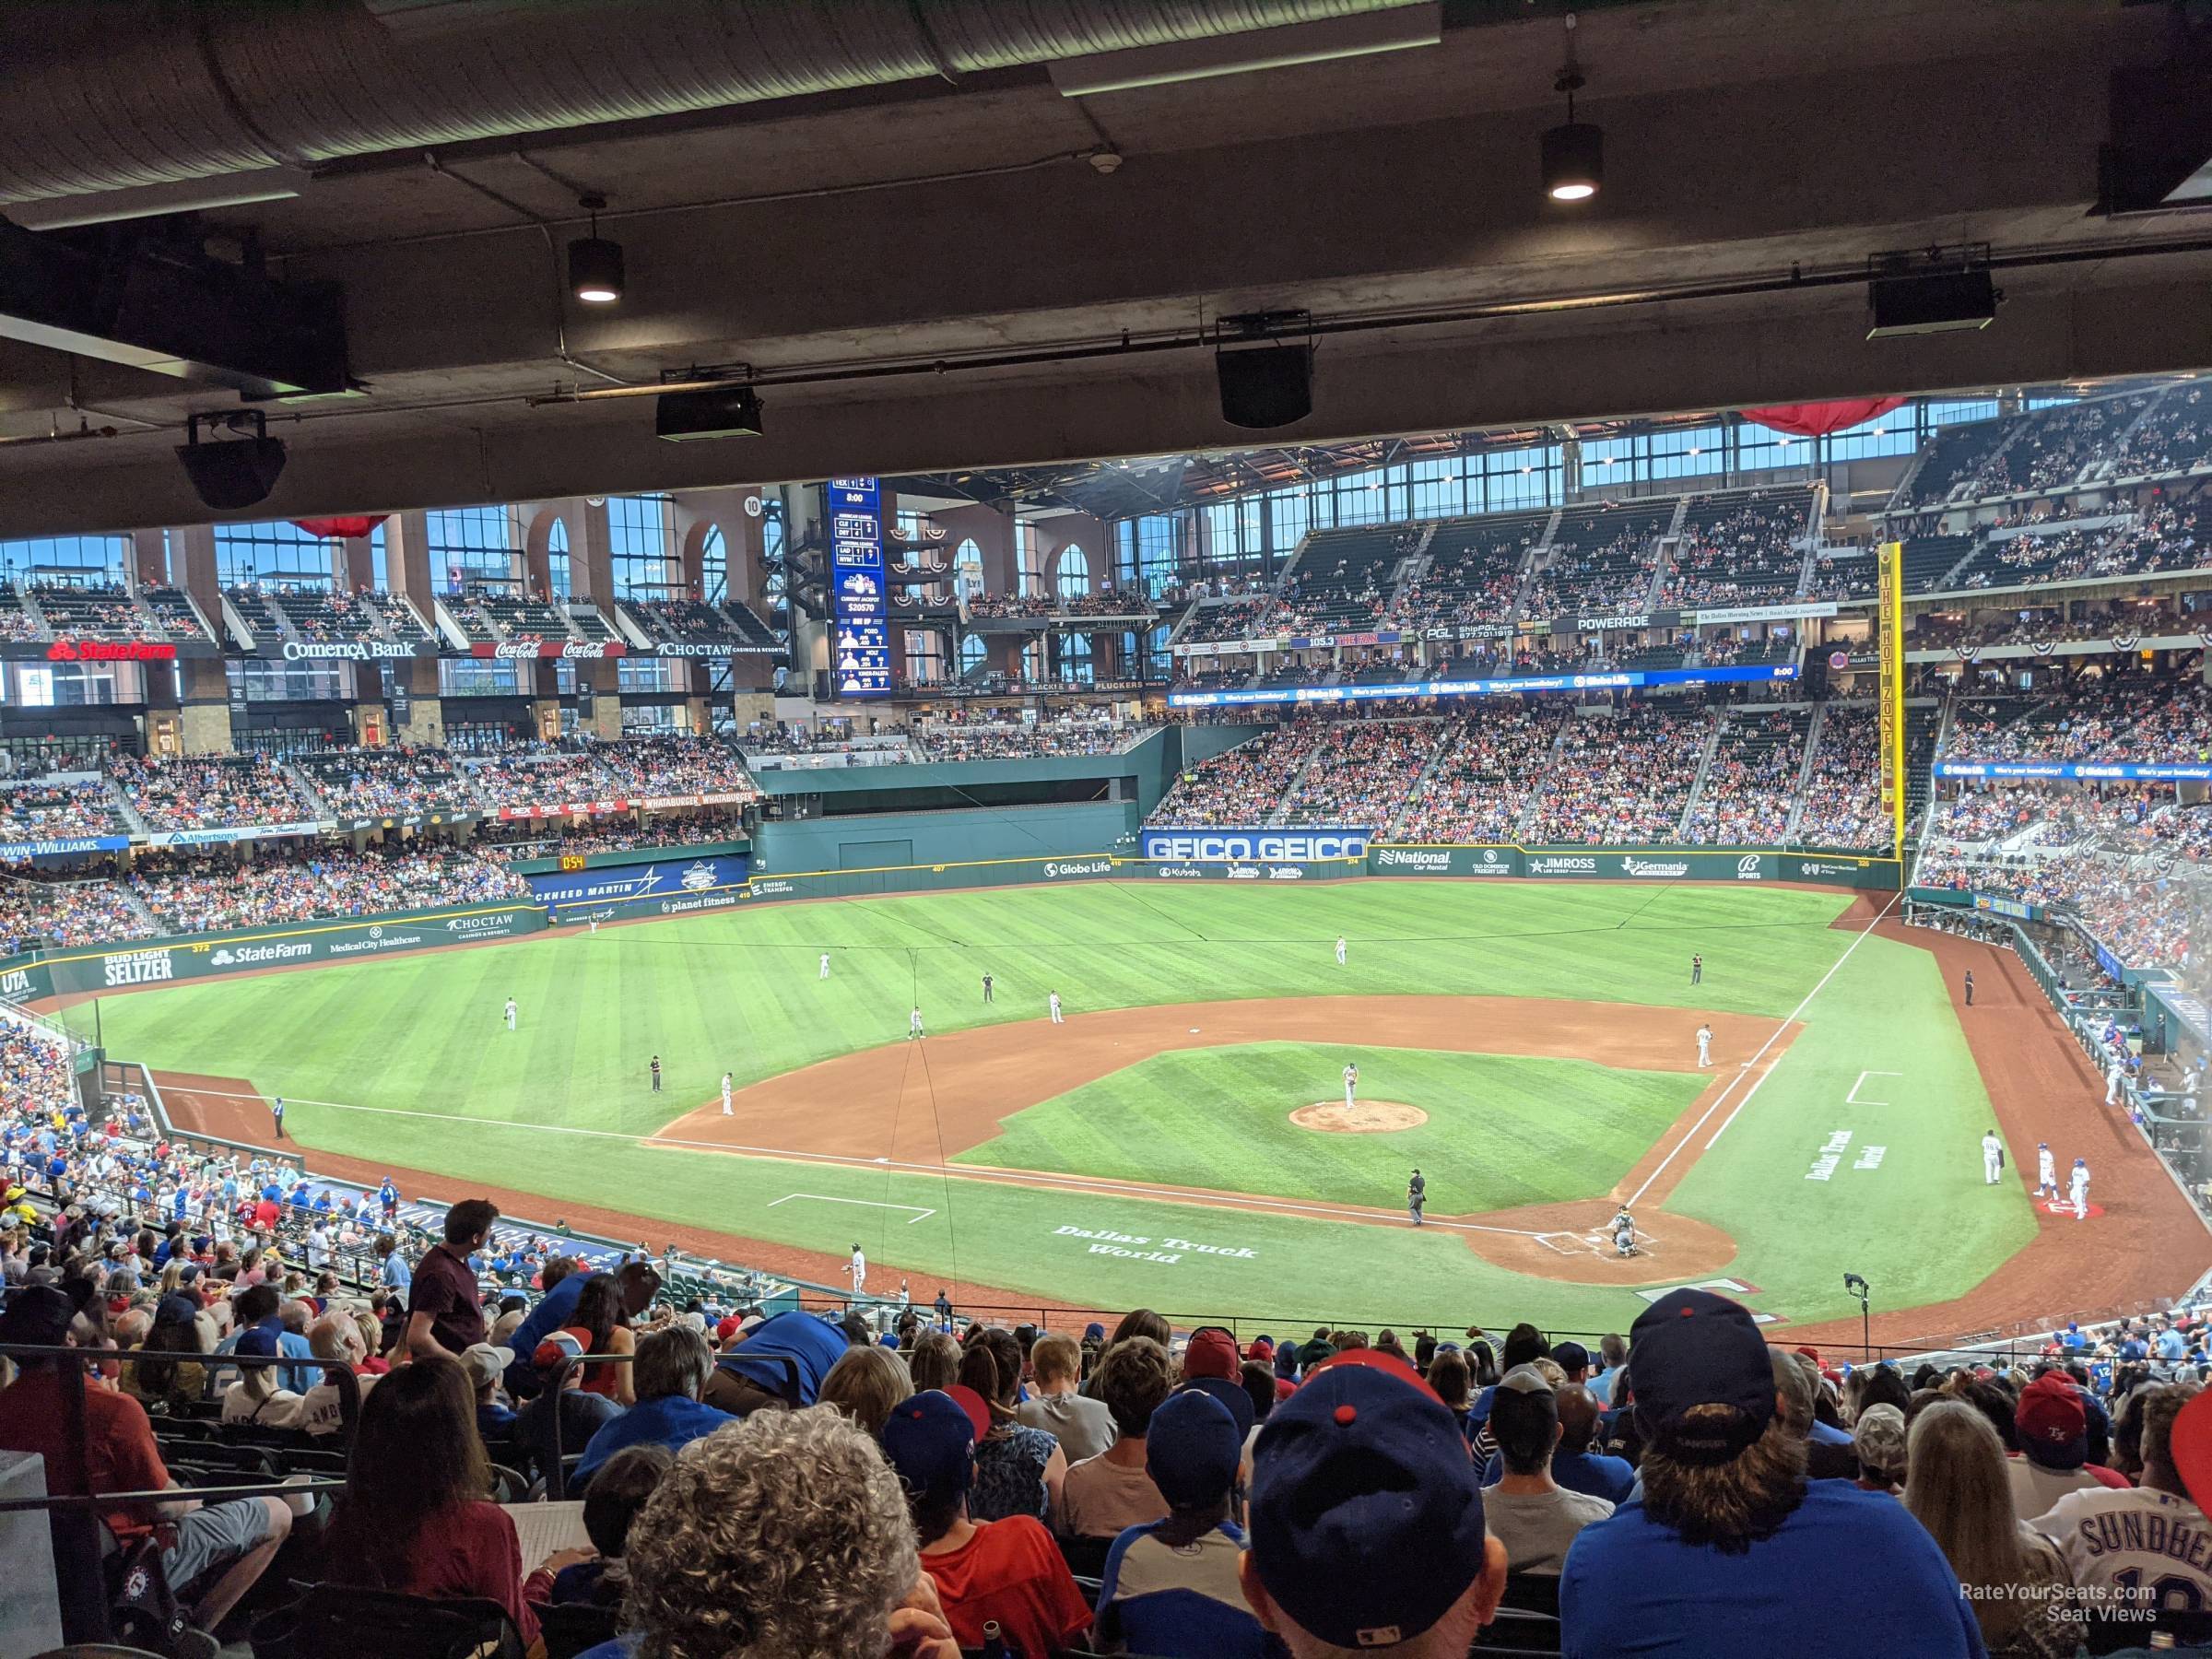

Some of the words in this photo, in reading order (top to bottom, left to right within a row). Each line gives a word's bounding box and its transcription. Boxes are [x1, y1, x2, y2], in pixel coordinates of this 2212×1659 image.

[847, 493, 863, 502] 8:00
[747, 500, 758, 512] 10
[1578, 615, 1649, 630] POWERADE
[1427, 628, 1453, 639] PGL
[1459, 625, 1513, 633] ShipPGL.com
[1310, 637, 1334, 647] 105.3
[1336, 635, 1355, 645] THE
[1357, 633, 1378, 645] FAN
[371, 641, 416, 657] Bank
[665, 643, 732, 655] CHOCTAW
[1774, 667, 1793, 676] 8:00
[1095, 681, 1143, 690] PLUCKERS
[1883, 688, 1892, 746] ZONE
[645, 797, 698, 808] WHATABURGER
[703, 793, 753, 804] WHATABURGER
[511, 806, 532, 815] DEX
[540, 805, 560, 813] DEX
[568, 803, 588, 811] DEX
[596, 801, 615, 809] DEX
[276, 825, 300, 834] Thumb
[187, 833, 238, 843] Albertsons
[1148, 838, 1251, 859] GEICO
[1259, 838, 1367, 859] GEICO
[563, 857, 583, 870] 0:54
[1060, 865, 1090, 874] Globe
[1092, 862, 1110, 873] Life
[1640, 862, 1687, 871] Germania
[1172, 868, 1201, 877] Kubota
[588, 884, 632, 896] MARTIN
[671, 901, 702, 912] planet
[704, 896, 735, 907] fitness
[454, 914, 513, 930] CHOCTAW
[192, 945, 210, 953] 372
[330, 943, 362, 953] Medical
[362, 941, 378, 951] City
[380, 935, 421, 947] Healthcare
[105, 954, 132, 965] BUD
[137, 949, 170, 961] LIGHT
[105, 959, 173, 986] SELTZER
[2, 970, 29, 994] UTA
[1053, 1225, 1150, 1244] Dallas
[1160, 1238, 1259, 1259] Truck
[1088, 1244, 1182, 1264] World
[2098, 1366, 2110, 1377] 12
[2080, 1511, 2212, 1572] SUNDBE
[172, 1619, 183, 1633] 16
